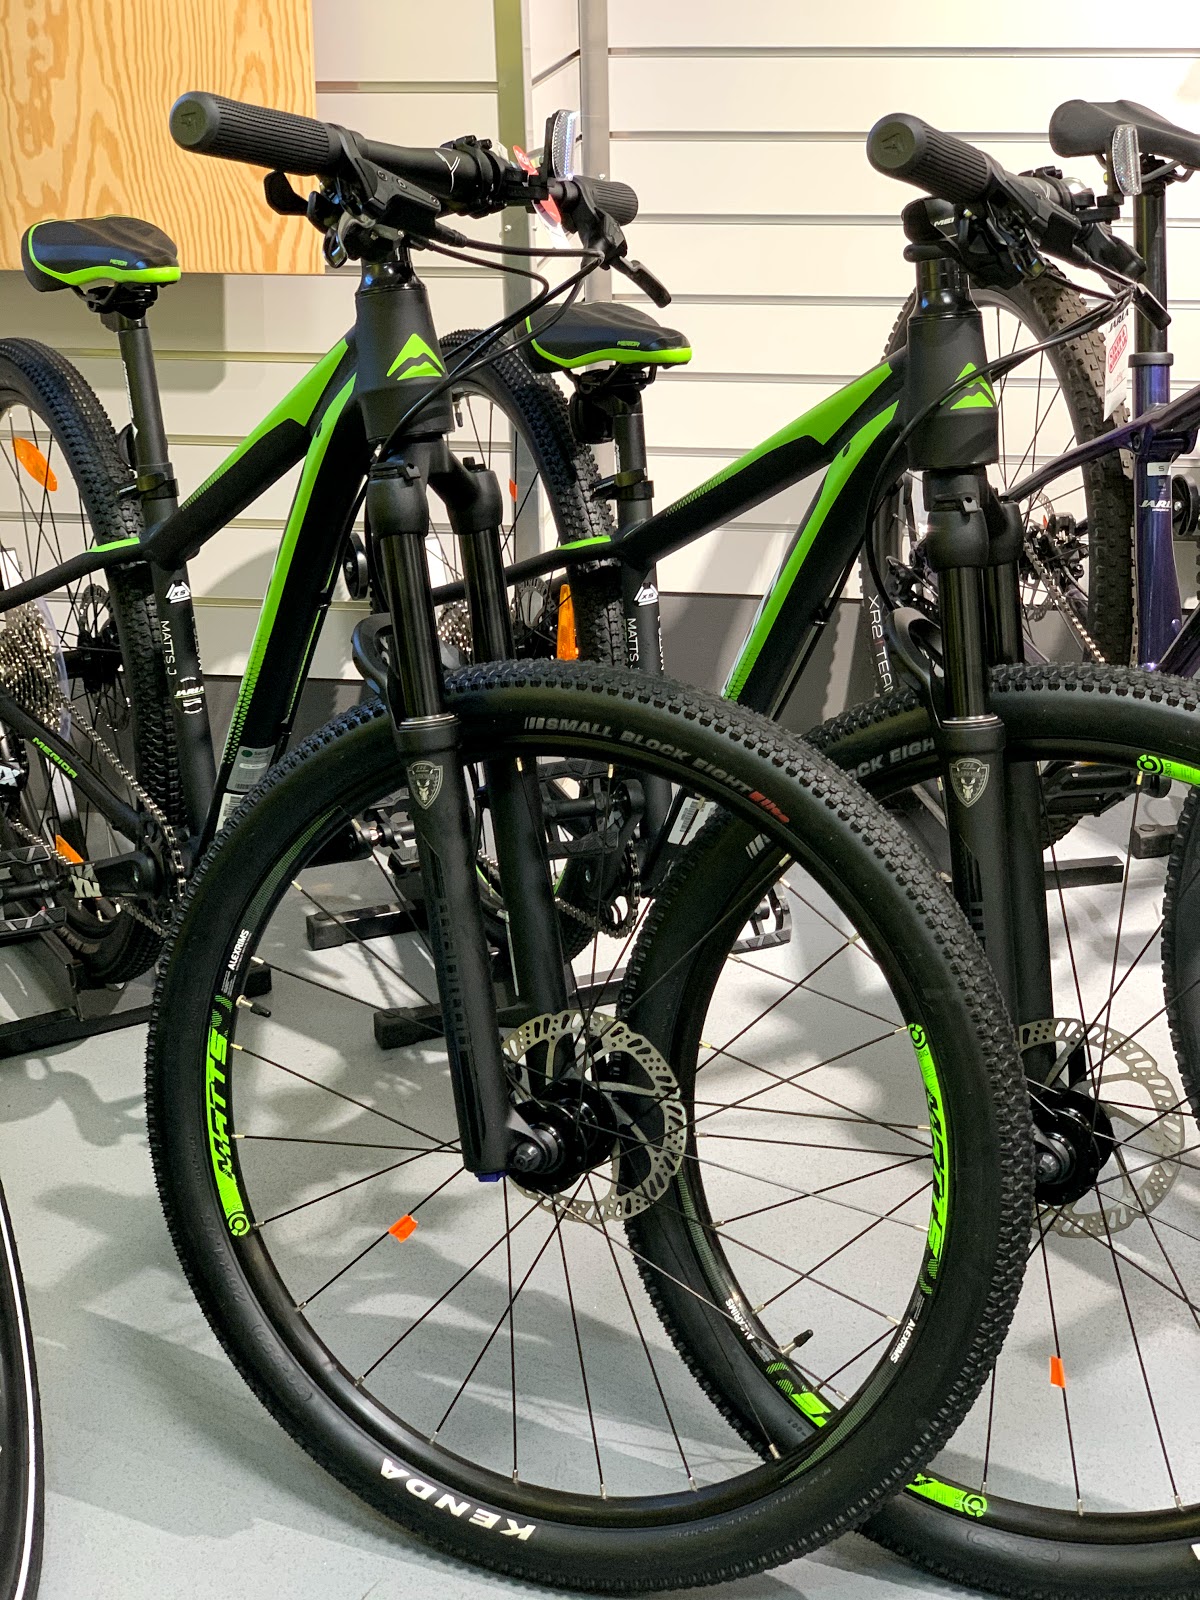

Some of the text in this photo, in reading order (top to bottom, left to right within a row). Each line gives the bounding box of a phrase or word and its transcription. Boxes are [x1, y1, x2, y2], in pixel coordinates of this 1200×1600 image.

[626, 617, 640, 662] MATTS
[867, 594, 884, 640] XR2
[159, 619, 176, 665] MATTS
[31, 736, 79, 780] MERIDA
[545, 717, 614, 739] SMALL
[619, 730, 693, 761] BLOCK
[691, 757, 756, 794] EIGHT
[226, 927, 251, 972] ALEXRIMS
[205, 1027, 233, 1181] MATTS
[889, 1317, 917, 1365] ALEXRIMS
[380, 1457, 537, 1541] KENDA
